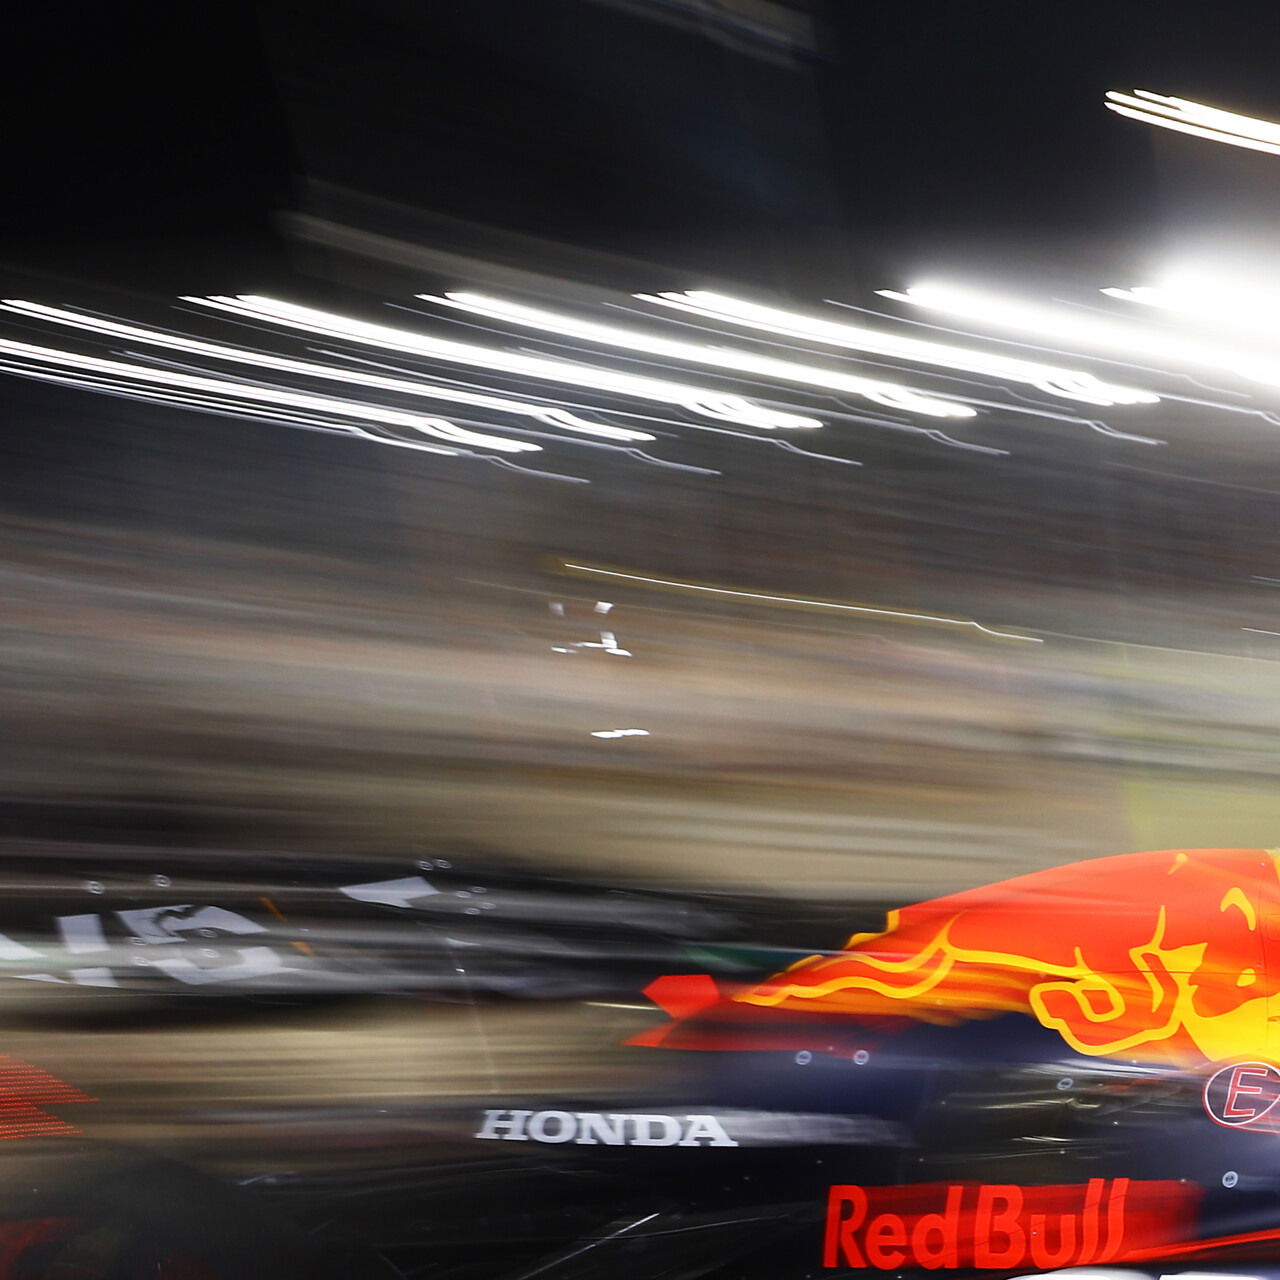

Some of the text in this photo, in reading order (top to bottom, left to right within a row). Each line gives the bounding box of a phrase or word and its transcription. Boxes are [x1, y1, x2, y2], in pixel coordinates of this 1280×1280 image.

[474, 1109, 739, 1147] HONDA
[823, 1177, 1130, 1270] Red Bull
